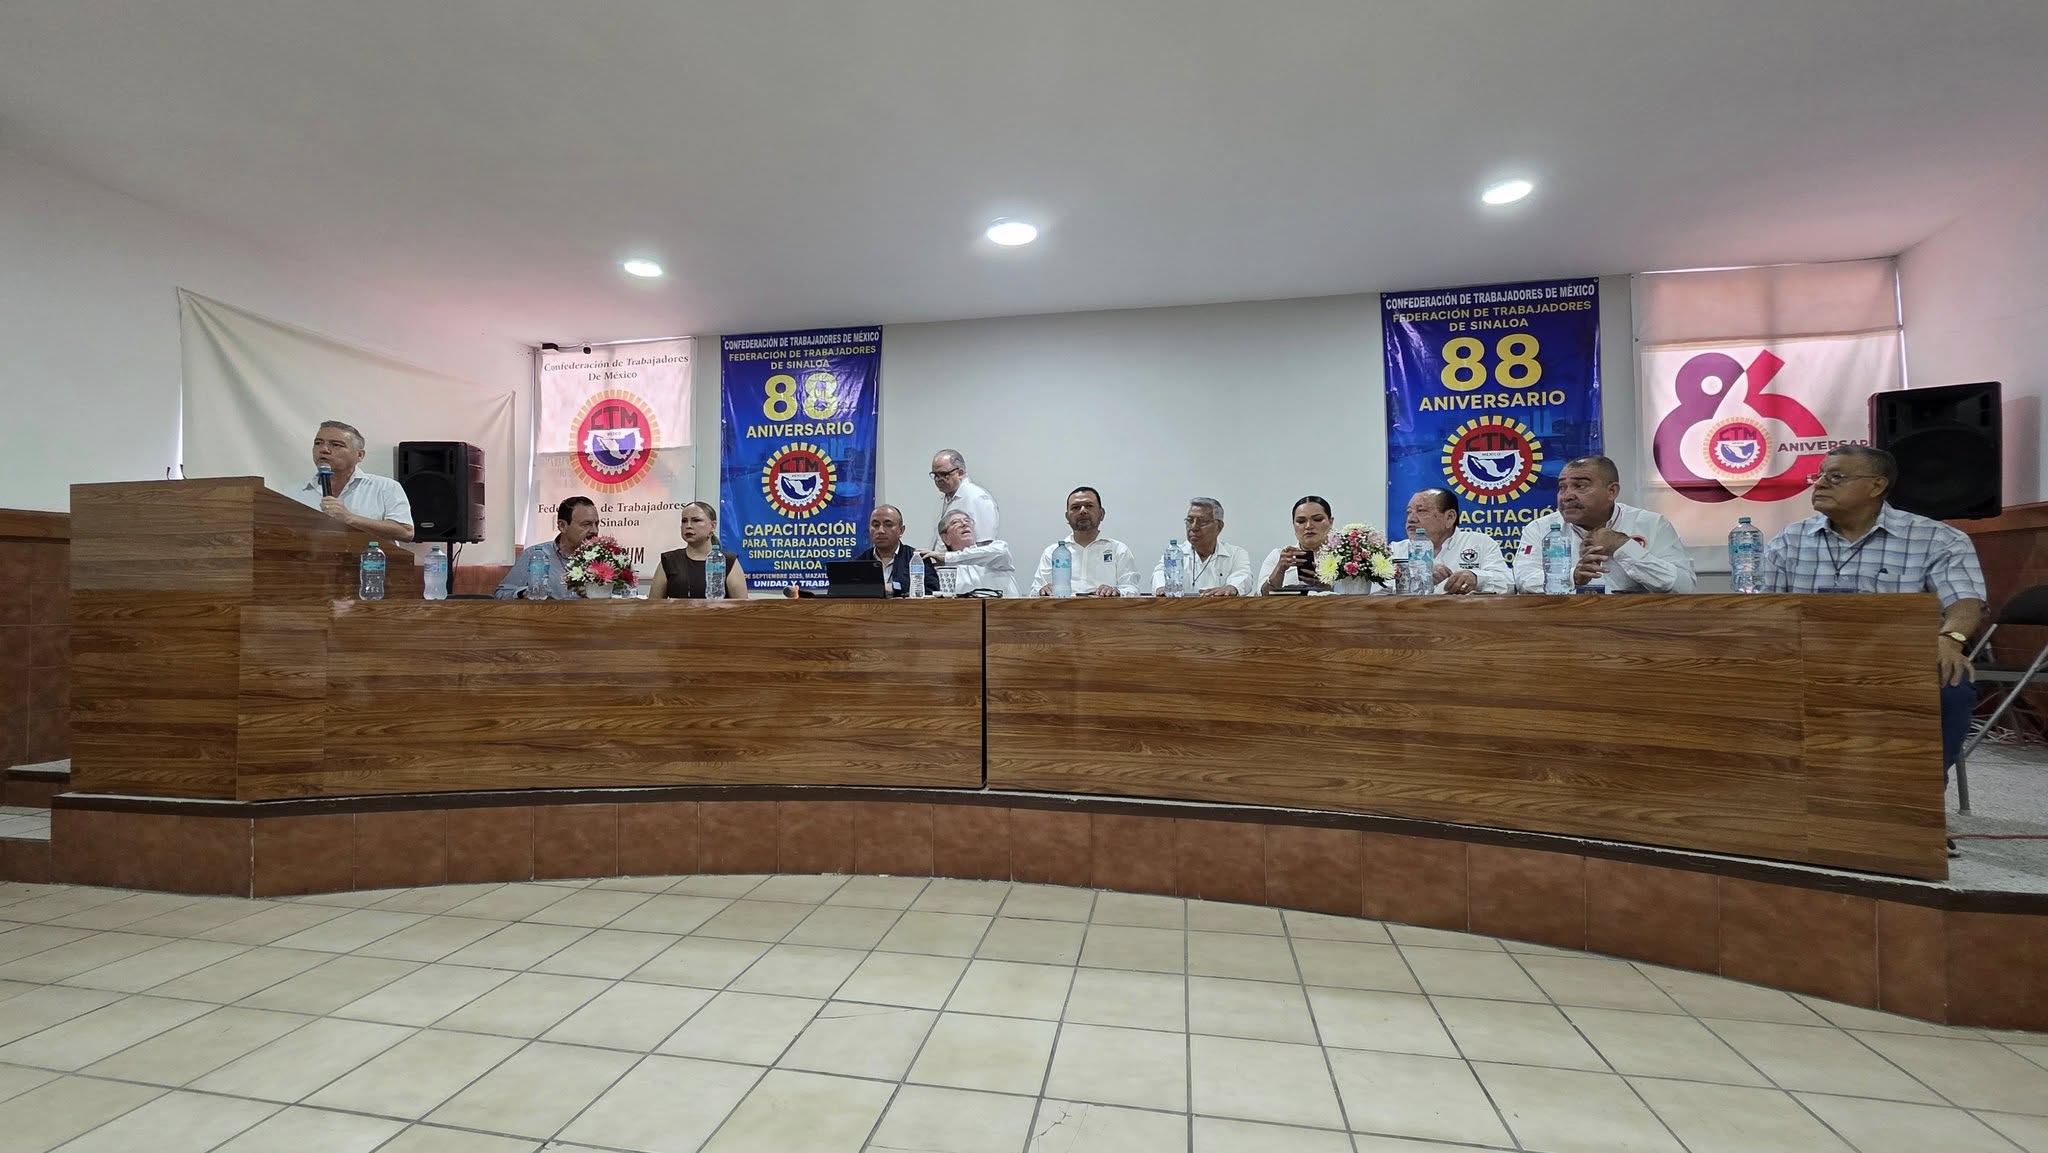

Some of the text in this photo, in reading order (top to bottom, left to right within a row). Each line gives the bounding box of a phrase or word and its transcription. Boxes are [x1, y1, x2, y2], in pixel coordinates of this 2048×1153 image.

[1386, 283, 1595, 310] CONFEDERACIÓN DE TRABAJADORES DE MÉXICO
[1392, 300, 1592, 322] FEDERACIÓN DE TRABAJADORES
[1450, 318, 1528, 332] DE SINALOA
[724, 330, 880, 350] CONFEDERACIÓN DE TRABAJADORES DE MÉXICO
[729, 346, 876, 362] FEDERACIÓN DE TRABAJADORES
[544, 354, 689, 372] Confederación de Trabajadores
[770, 359, 830, 370] DE SINALOA
[1440, 333, 1542, 392] 88
[588, 370, 638, 382] De México
[763, 372, 839, 422] 88
[1418, 390, 1566, 412] ANIVERSARIO
[591, 406, 638, 430] CTM
[746, 422, 854, 438] ANIVERSARIO
[1719, 427, 1757, 441] CTM
[1465, 432, 1518, 452] CTM
[1778, 440, 1868, 452] ANIVERSAR
[780, 456, 819, 473] CTM
[600, 502, 685, 514] de Trabajadores
[1458, 506, 1554, 524] ACITACIÓ
[600, 518, 640, 528] Sinaloa
[744, 520, 856, 536] CAPACITACIÓN
[742, 538, 856, 548] PARA TRABAJADORES
[748, 549, 852, 559] SINDICALIZADOS DE
[774, 560, 822, 570] SINALOA
